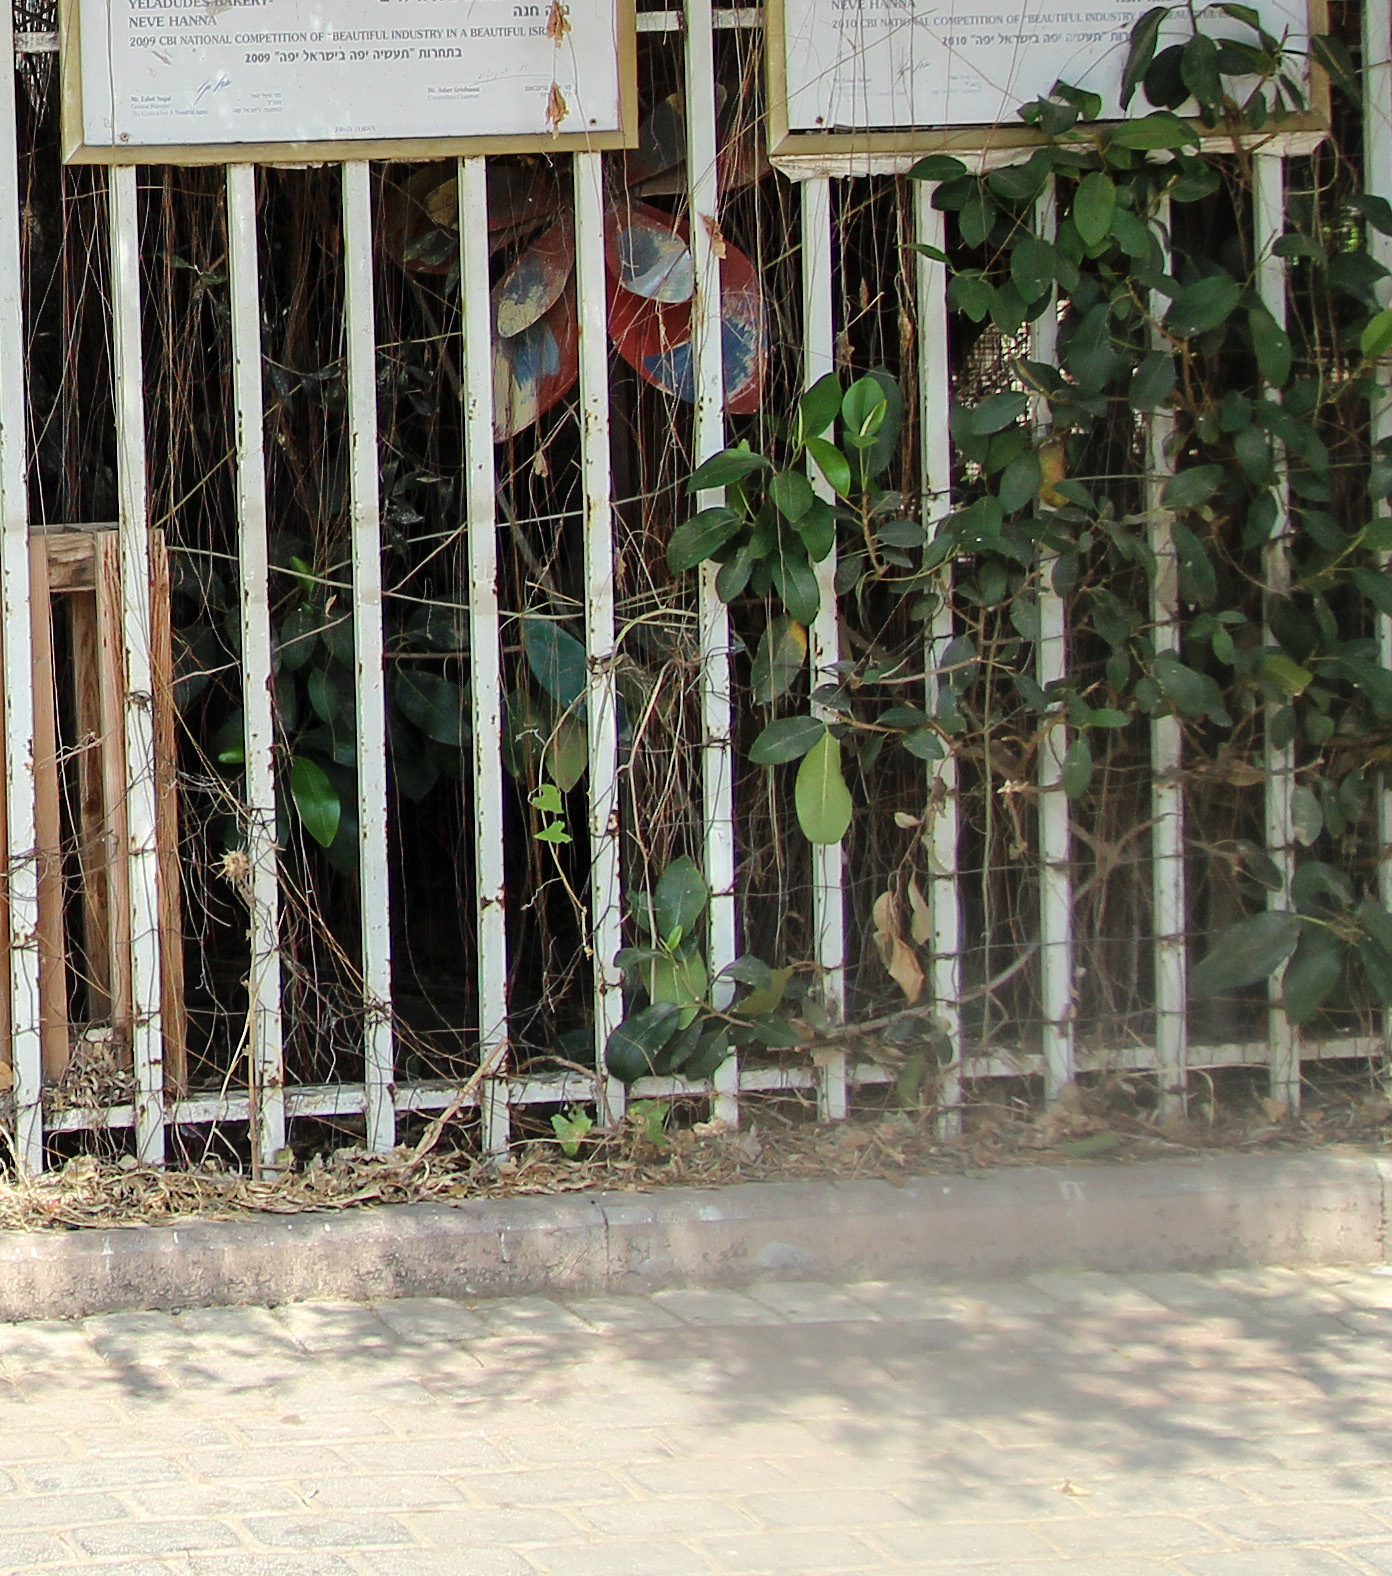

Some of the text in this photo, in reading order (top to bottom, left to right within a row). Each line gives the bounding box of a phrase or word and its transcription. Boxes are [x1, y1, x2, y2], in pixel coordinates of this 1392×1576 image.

[513, 5, 539, 17] חנה
[831, 0, 867, 11] NEVE
[129, 15, 217, 28] NEVE HANNA
[880, 17, 929, 27] NATIONAL
[933, 15, 1003, 26] COMPETITION
[1006, 15, 1020, 25] OF
[1085, 11, 1134, 22] INDUSTRY
[130, 36, 156, 47] 2009
[159, 36, 177, 46] CBI
[180, 34, 232, 45] NATIONAL
[235, 32, 307, 44] COMPETITION
[310, 32, 325, 42] OF
[391, 29, 443, 40] INDUSTRY
[446, 28, 458, 39] IN
[459, 28, 468, 38] A
[470, 27, 526, 38] BEAUTIFUL
[245, 53, 271, 64] 2009
[349, 50, 369, 61] יפה
